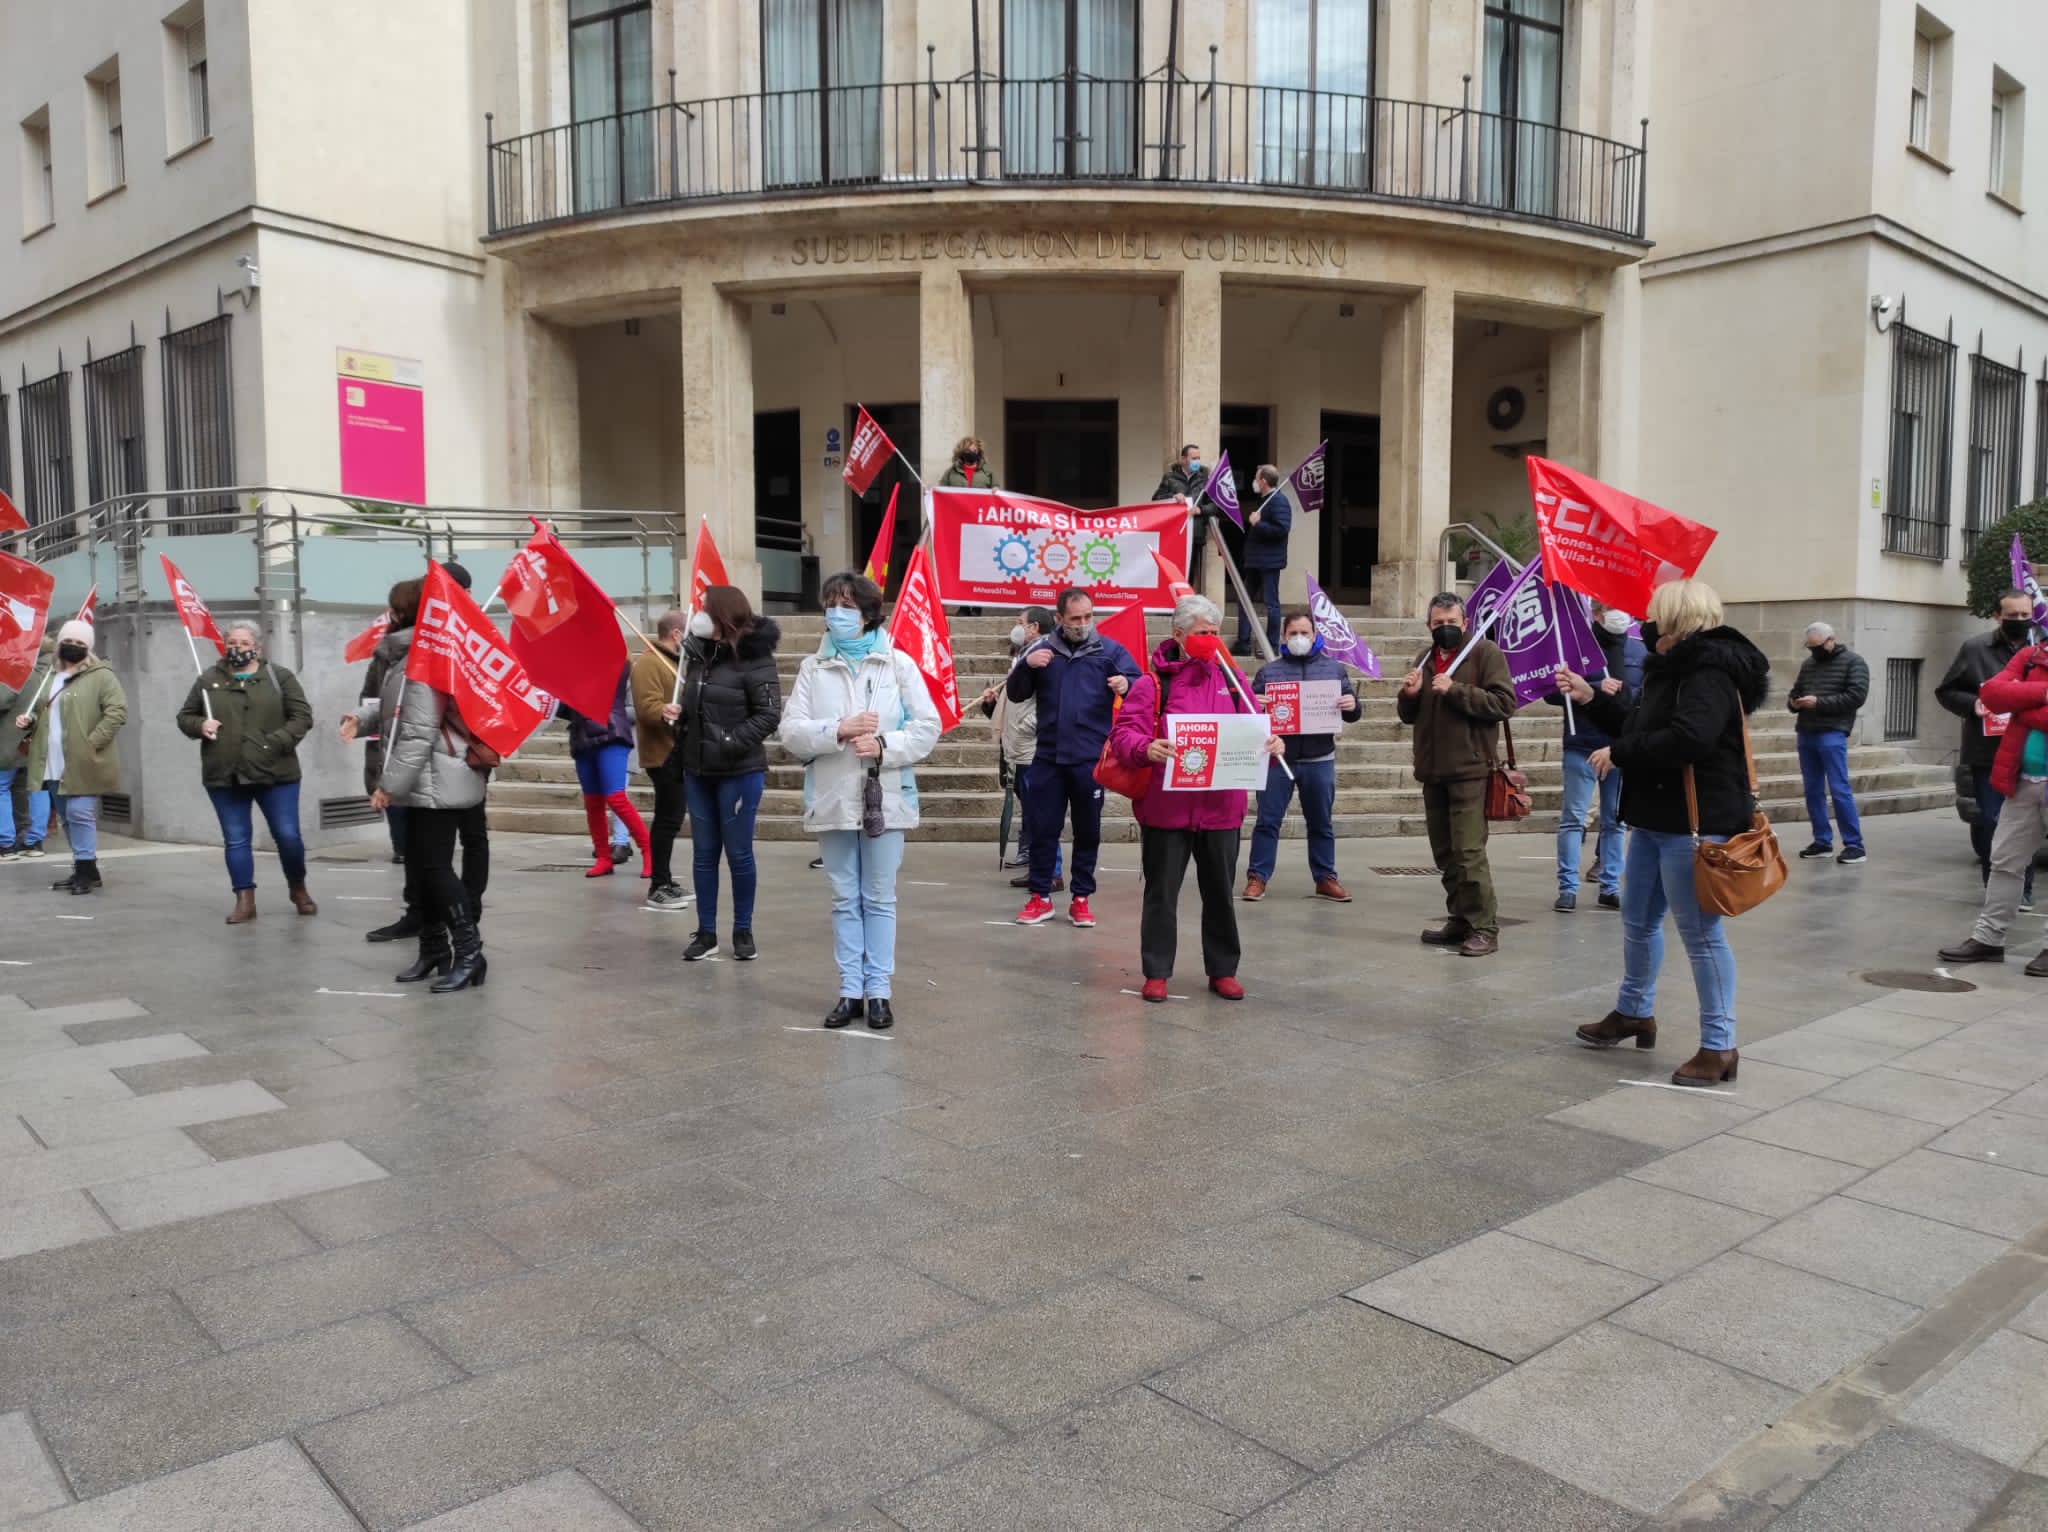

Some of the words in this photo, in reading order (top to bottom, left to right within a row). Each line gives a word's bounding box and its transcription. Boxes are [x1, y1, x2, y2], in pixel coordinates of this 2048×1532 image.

[1096, 230, 1162, 261] DEL
[1180, 232, 1348, 268] GOBIERNO
[977, 505, 1052, 526] ¡AHORA
[1054, 510, 1077, 529] SÍ
[1080, 515, 1138, 529] TOCA!
[422, 597, 516, 682] CCOO
[1177, 733, 1188, 746] SÍ
[1190, 736, 1216, 745] TOCA!
